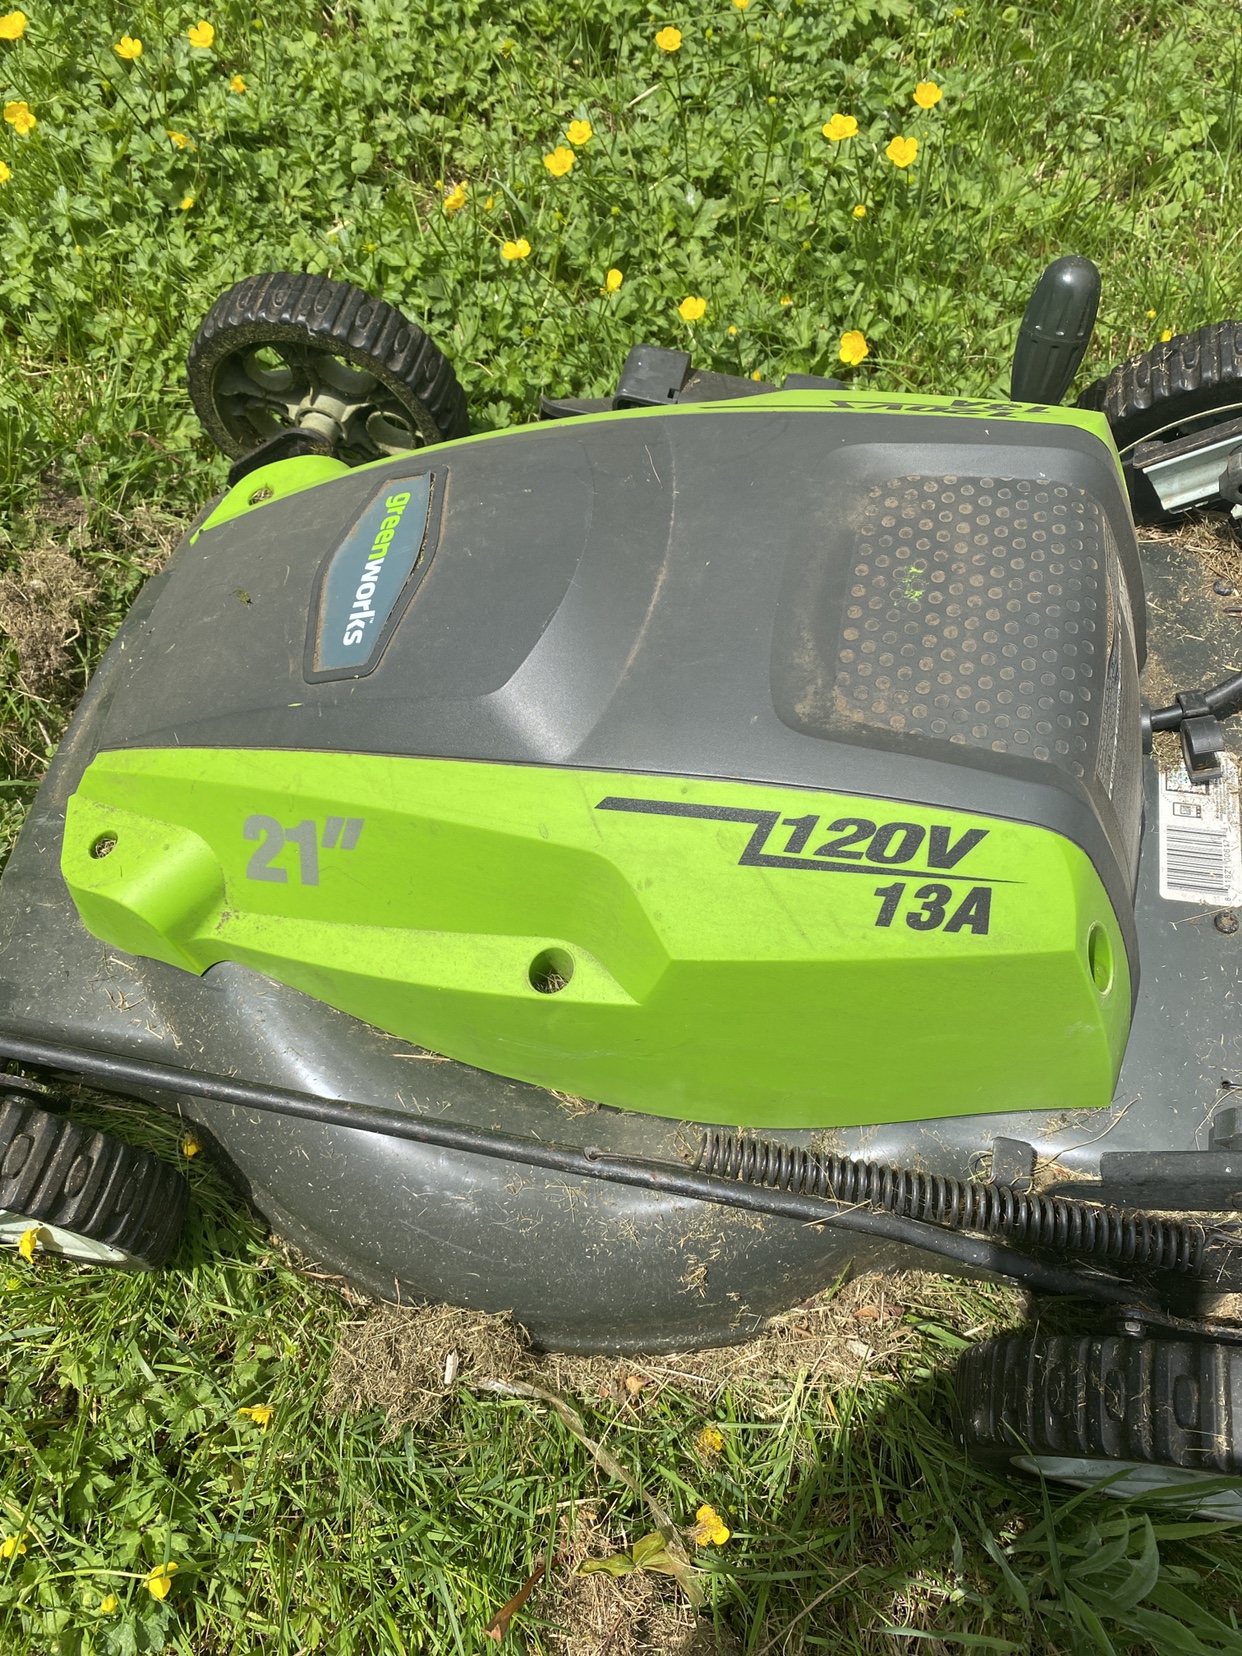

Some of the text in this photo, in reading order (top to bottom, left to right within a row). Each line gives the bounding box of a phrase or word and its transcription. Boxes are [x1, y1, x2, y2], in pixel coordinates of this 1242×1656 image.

[343, 491, 411, 646] greenworks
[242, 813, 366, 887] 21"
[781, 813, 990, 869] 120V
[873, 881, 993, 936] 13A
